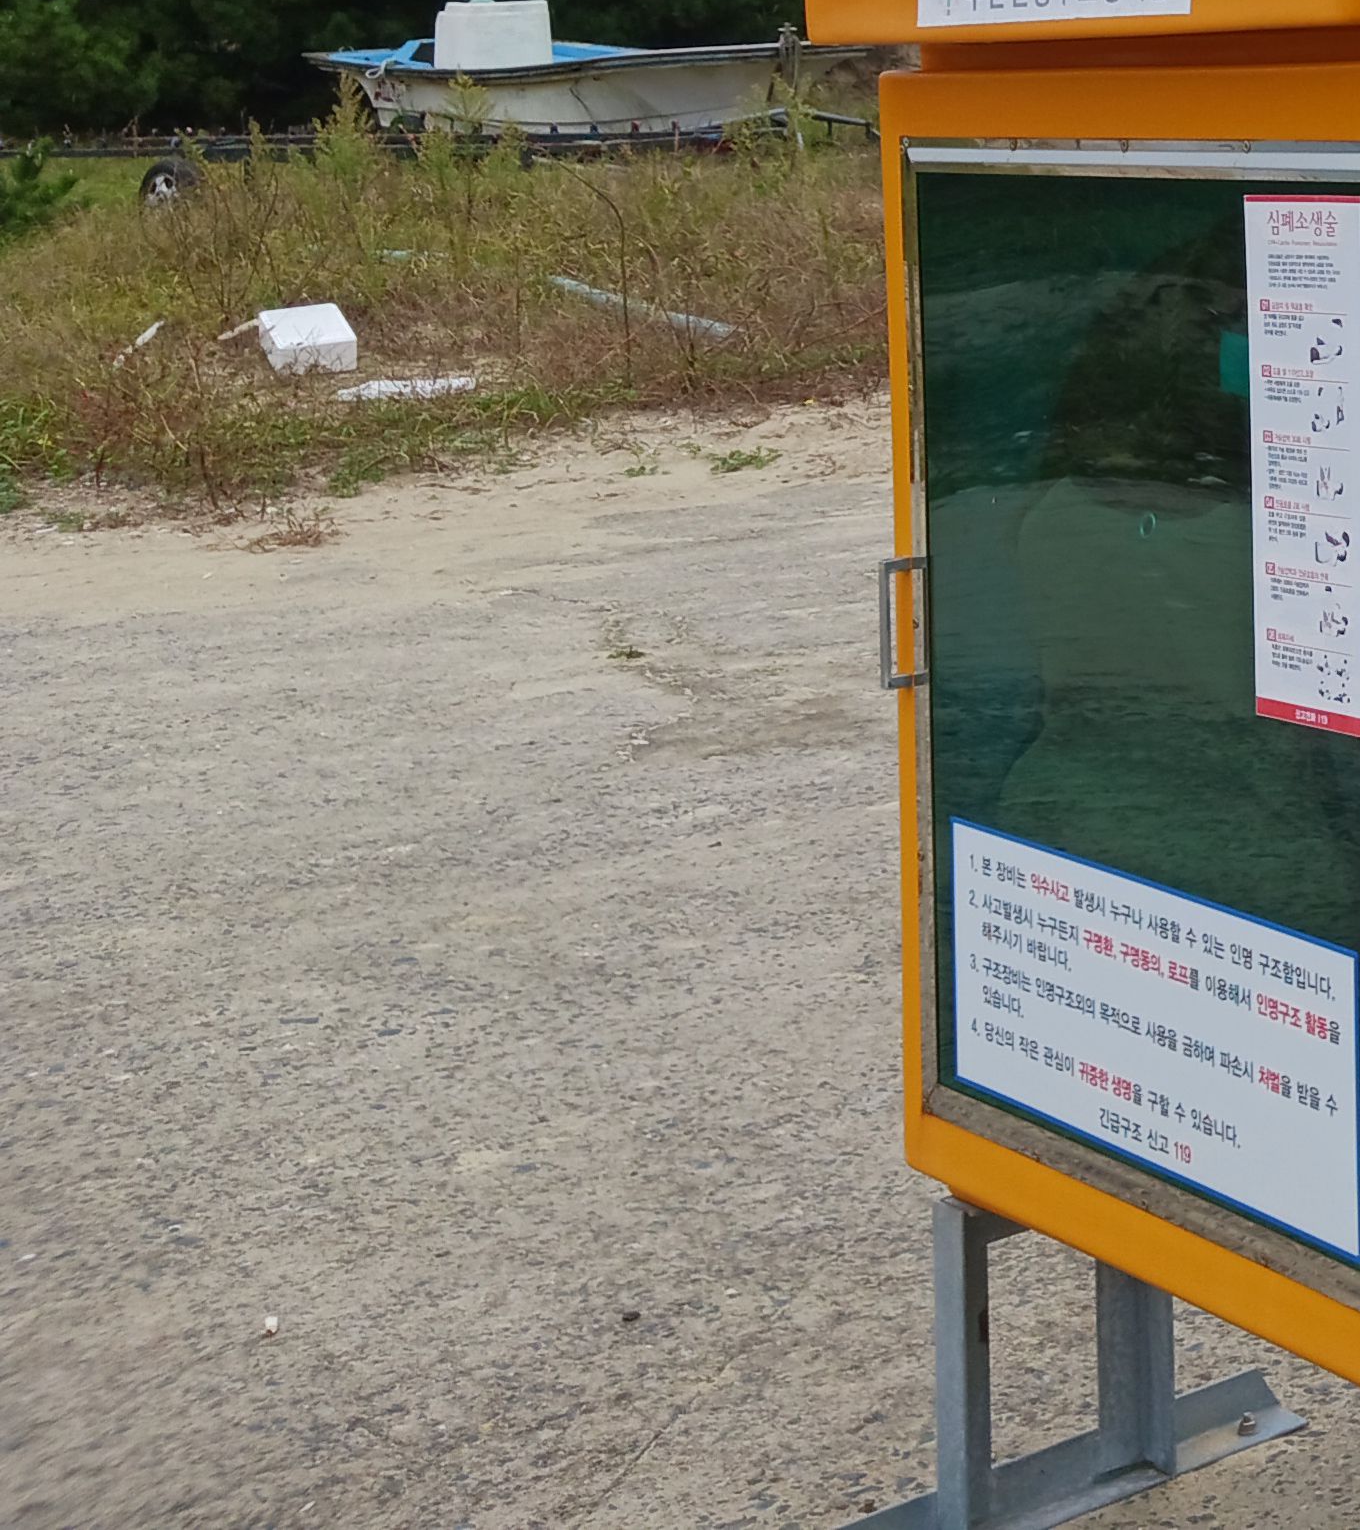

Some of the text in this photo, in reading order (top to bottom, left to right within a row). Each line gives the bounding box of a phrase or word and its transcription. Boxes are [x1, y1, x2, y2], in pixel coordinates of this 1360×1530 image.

[1266, 209, 1338, 237] 심폐소생술
[982, 857, 992, 877] 본
[996, 862, 1026, 889] 장비는
[1031, 873, 1070, 902] 익수사고
[1074, 888, 1105, 916] 발생시
[1110, 901, 1143, 930] 누구나
[1147, 916, 1181, 944] 사용할
[1185, 928, 1197, 948] 수
[1202, 933, 1225, 960] 있는
[1230, 943, 1252, 970] 인명
[1258, 953, 1335, 1000] 구조함입니다.
[982, 922, 1071, 971] 해주시기 바랍니다.
[982, 895, 1032, 928] 사고발생시
[1037, 913, 1079, 945] 누구든지
[1168, 961, 1199, 991] 로프를
[1205, 976, 1251, 1011] 이용해서
[1257, 993, 1302, 1028] 인명구조
[1306, 1012, 1341, 1045] 활동을
[982, 958, 1031, 993] 구조장비는
[1036, 978, 1095, 1018] 인명구조외의
[1100, 1002, 1141, 1035] 목적으로
[1145, 1023, 1177, 1052] 사용을
[1182, 1035, 1214, 1067] 금하며
[1220, 1052, 1253, 1083] 파손시
[1259, 1070, 1292, 1099] 처벌을
[1297, 1082, 1321, 1111] 받을
[1325, 1094, 1338, 1116] 수
[983, 985, 1024, 1018] 있습니다.
[985, 1022, 1014, 1051] 당신의
[1019, 1036, 1039, 1061] 작은
[1043, 1046, 1074, 1076] 관심이
[1079, 1062, 1109, 1091] 귀중한
[1112, 1076, 1142, 1106] 생명을
[1147, 1091, 1170, 1117] 구할
[1174, 1102, 1186, 1123] 수
[1191, 1109, 1240, 1149] 있습니다.
[1100, 1108, 1191, 1164] 긴급구조 신고 119
